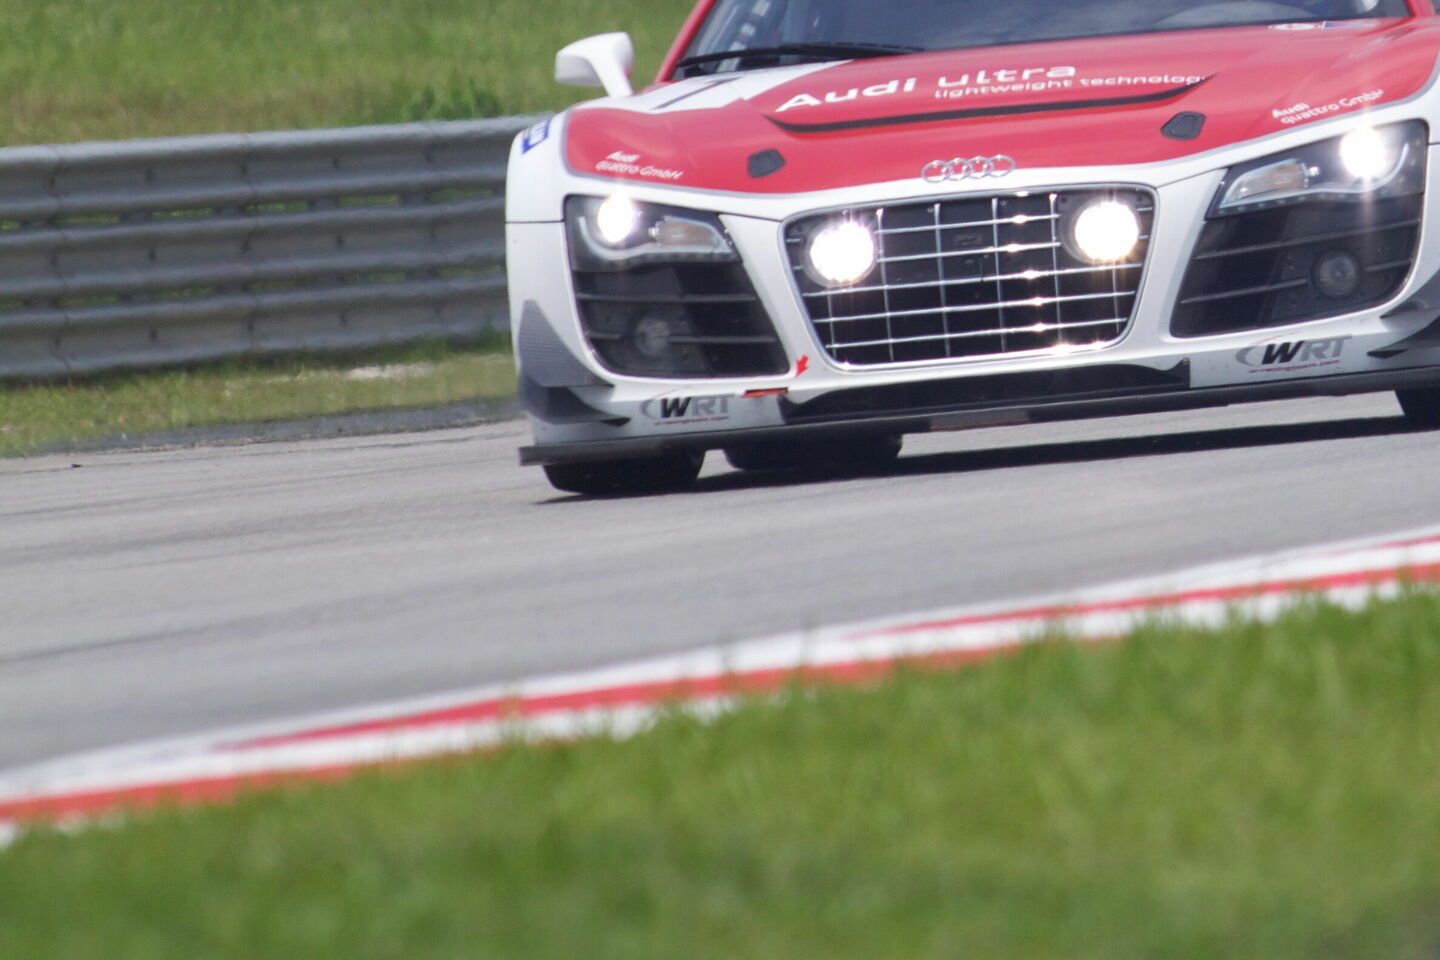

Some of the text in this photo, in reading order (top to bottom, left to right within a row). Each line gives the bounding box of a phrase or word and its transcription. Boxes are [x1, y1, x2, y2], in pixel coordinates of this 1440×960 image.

[774, 66, 1077, 112] Audi ultra
[934, 78, 1073, 99] lightweight
[1271, 102, 1309, 118] Audi
[1281, 103, 1340, 124] quattro
[1261, 333, 1353, 365] WRT
[660, 392, 735, 419] WRT
